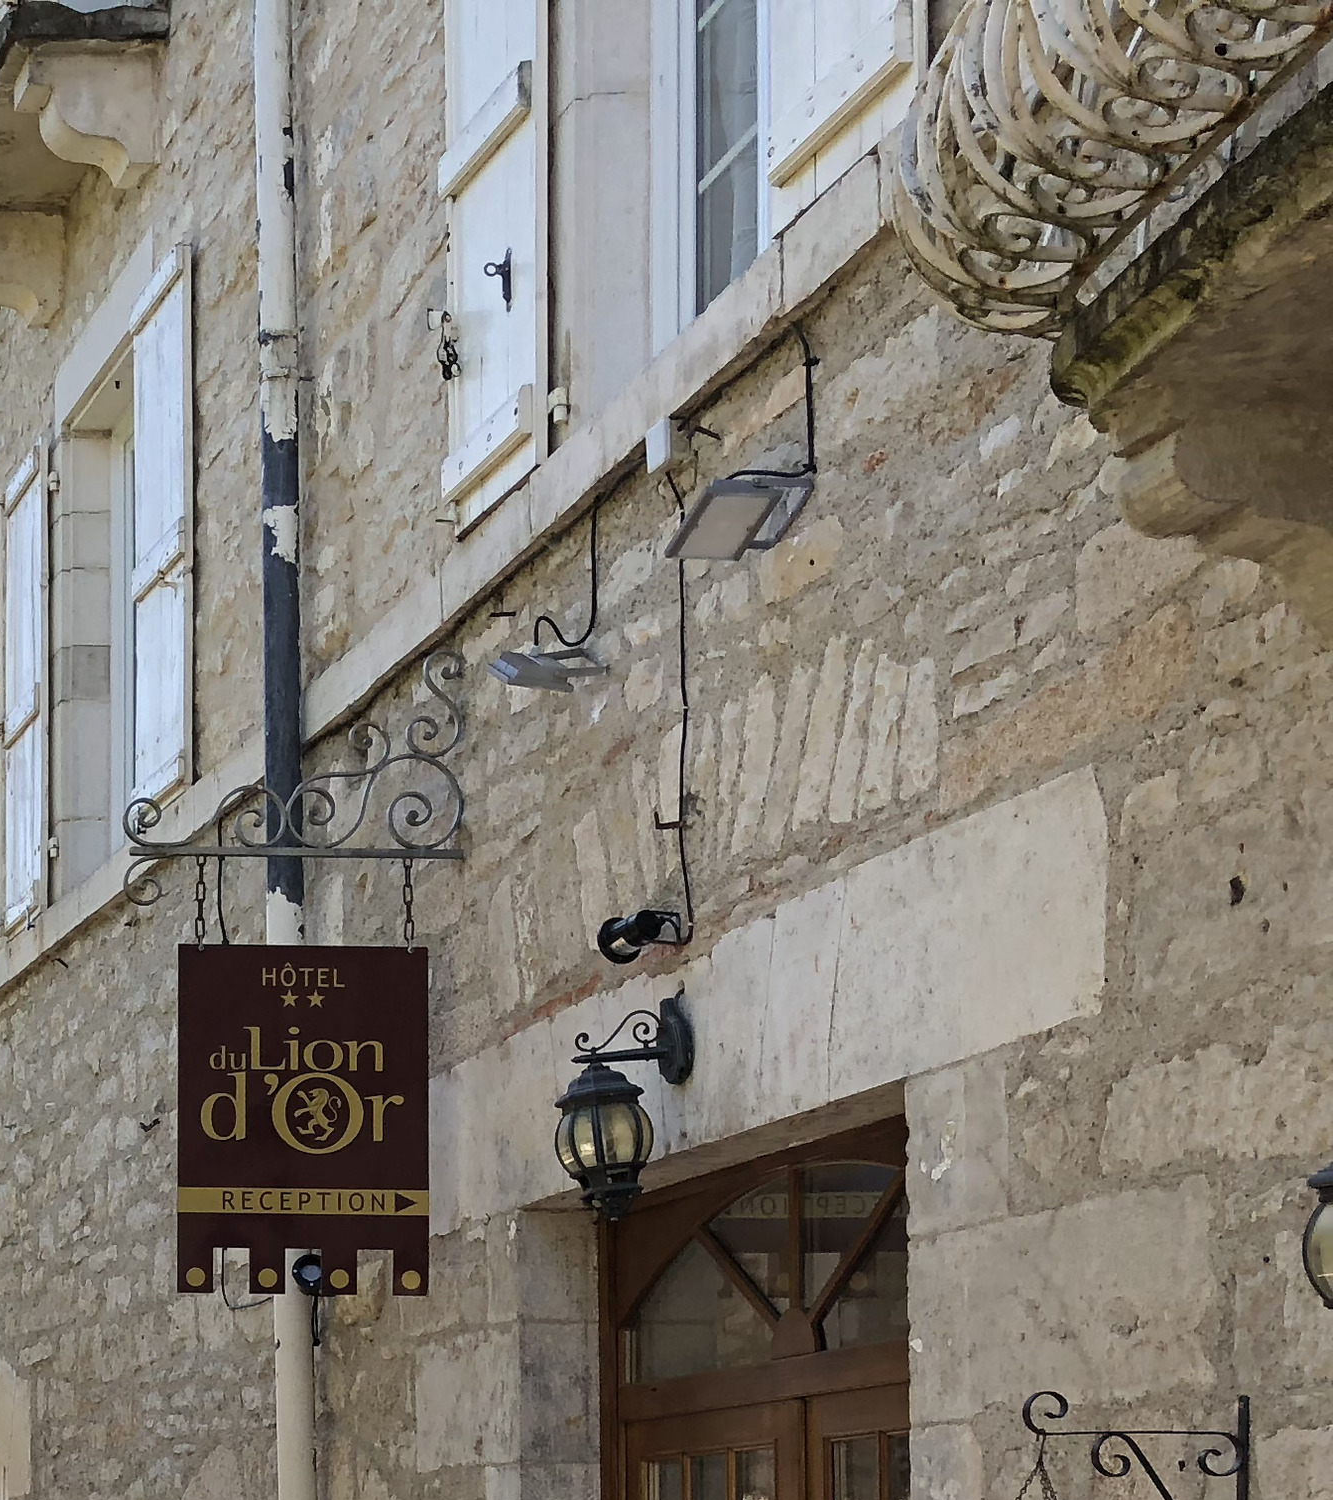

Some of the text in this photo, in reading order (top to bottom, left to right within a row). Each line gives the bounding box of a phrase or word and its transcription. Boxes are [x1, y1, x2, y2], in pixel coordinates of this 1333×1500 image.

[262, 962, 345, 988] HÔTEL
[210, 1026, 384, 1072] du Lion
[200, 1072, 405, 1154] d'Or
[221, 1191, 386, 1212] RECEPTION
